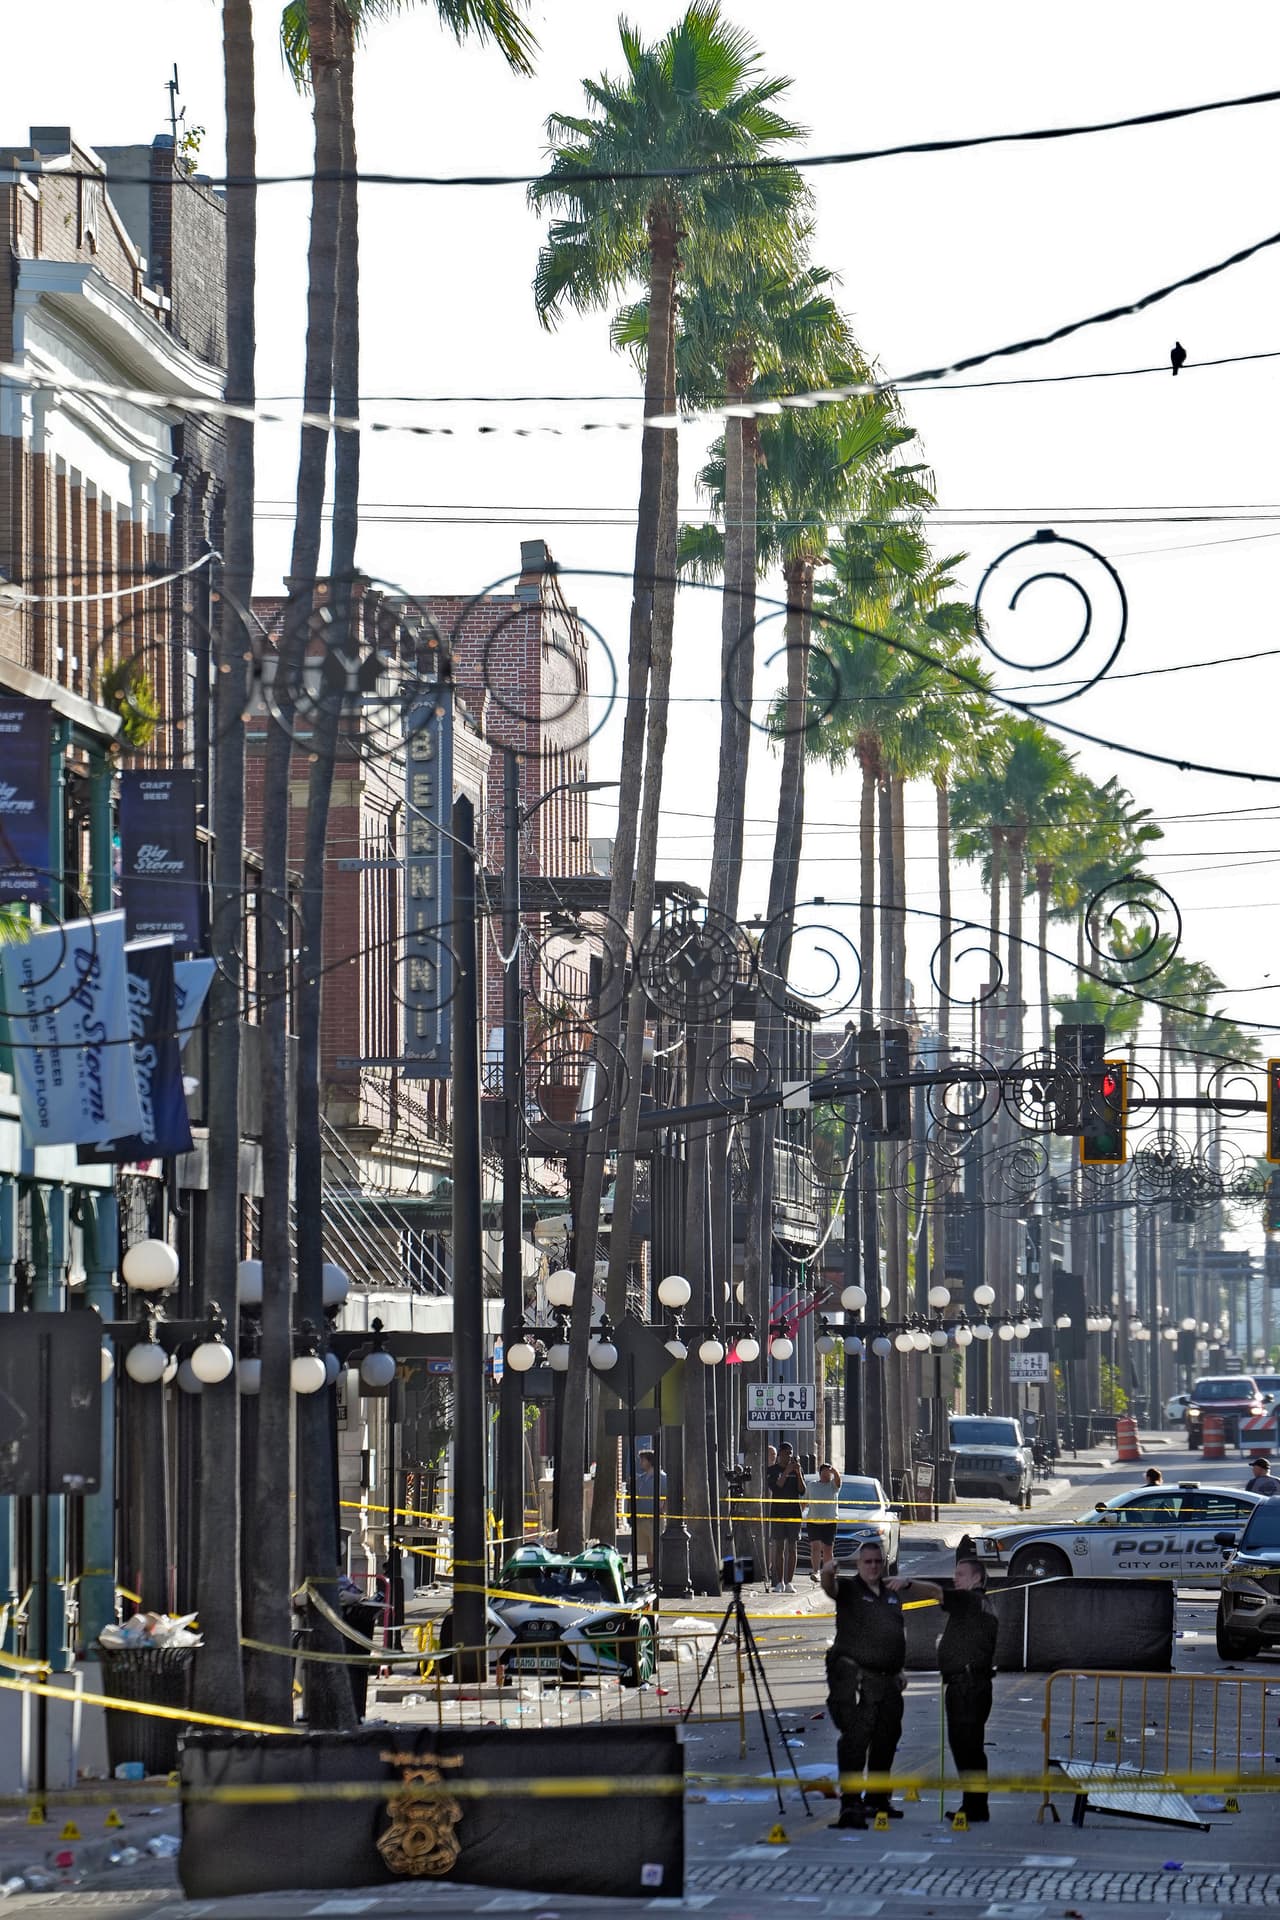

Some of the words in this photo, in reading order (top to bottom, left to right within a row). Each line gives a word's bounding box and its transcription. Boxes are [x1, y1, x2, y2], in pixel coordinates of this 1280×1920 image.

[140, 782, 172, 790] CRAFT
[137, 845, 169, 861] Big
[134, 858, 185, 870] Storm
[411, 729, 434, 1038] BERNINI
[136, 923, 185, 931] UPSTAIRS
[70, 948, 102, 1013] Big
[82, 1013, 108, 1124] Storm
[35, 1079, 49, 1129] FLOOR
[751, 1411, 768, 1420] PAY
[770, 1411, 782, 1420] BY
[784, 1411, 812, 1420] PLATE
[1112, 1540, 1224, 1556] POLIC
